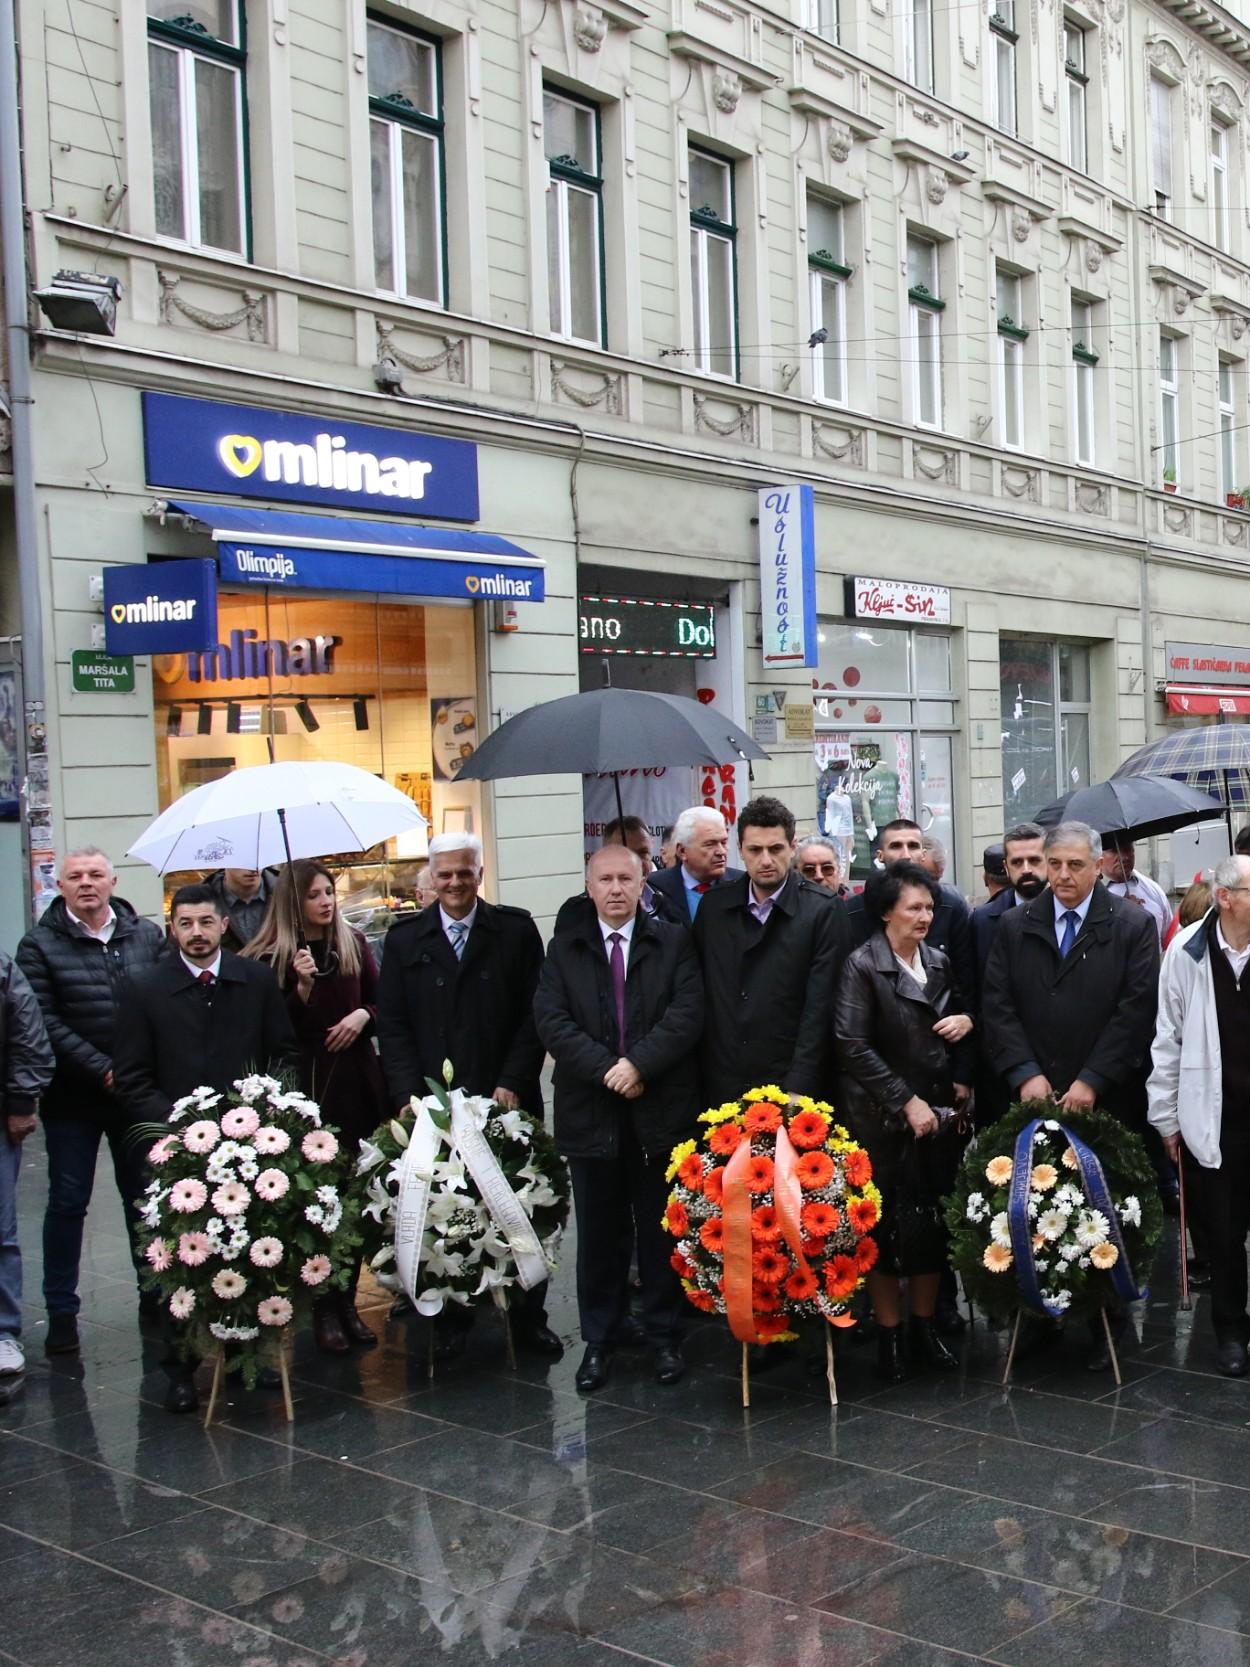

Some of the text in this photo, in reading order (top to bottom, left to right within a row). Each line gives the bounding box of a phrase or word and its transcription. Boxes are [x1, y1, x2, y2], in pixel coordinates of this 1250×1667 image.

[263, 434, 432, 499] mlinar
[765, 493, 790, 652] Uslužnost
[481, 574, 532, 597] mlinar
[858, 579, 948, 595] MALOPRODAJA
[126, 597, 196, 624] mlinar
[187, 629, 342, 682] mlinar
[79, 664, 128, 676] MARŠALA
[93, 678, 115, 688] TITA
[847, 752, 873, 771] Nova
[838, 774, 882, 800] Kolekcija
